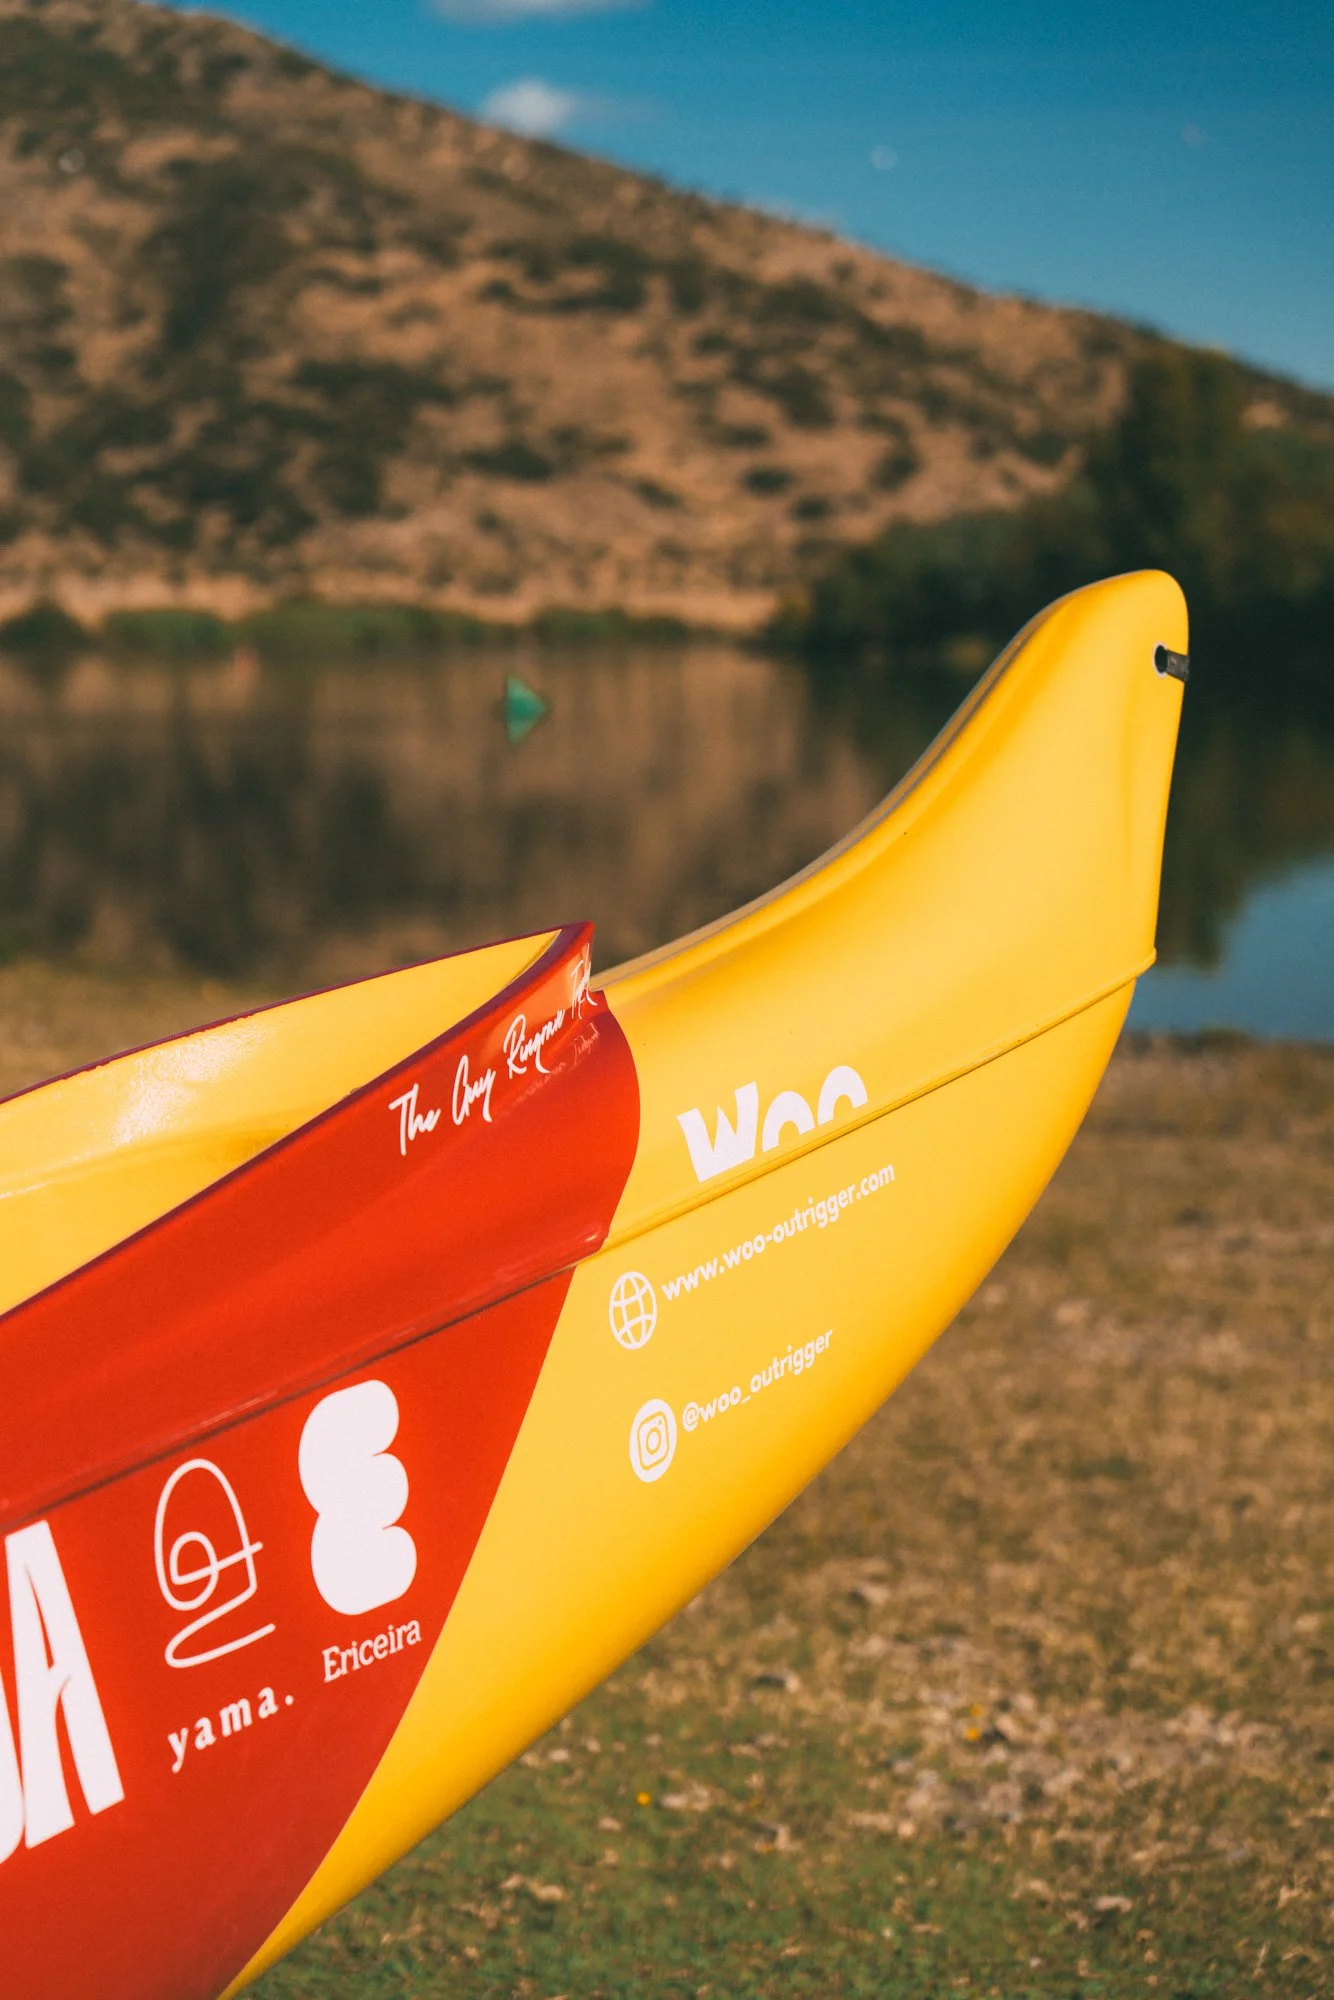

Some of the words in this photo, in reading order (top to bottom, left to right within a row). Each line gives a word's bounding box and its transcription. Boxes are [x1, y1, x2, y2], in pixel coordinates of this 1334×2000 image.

[388, 1082, 441, 1156] The
[661, 1164, 895, 1300] www.woo-outrigger.com
[682, 1329, 833, 1432] @woo_outrigger
[0, 1519, 125, 1865] A
[322, 1619, 422, 1684] Ericeira
[168, 1687, 294, 1773] yama.
